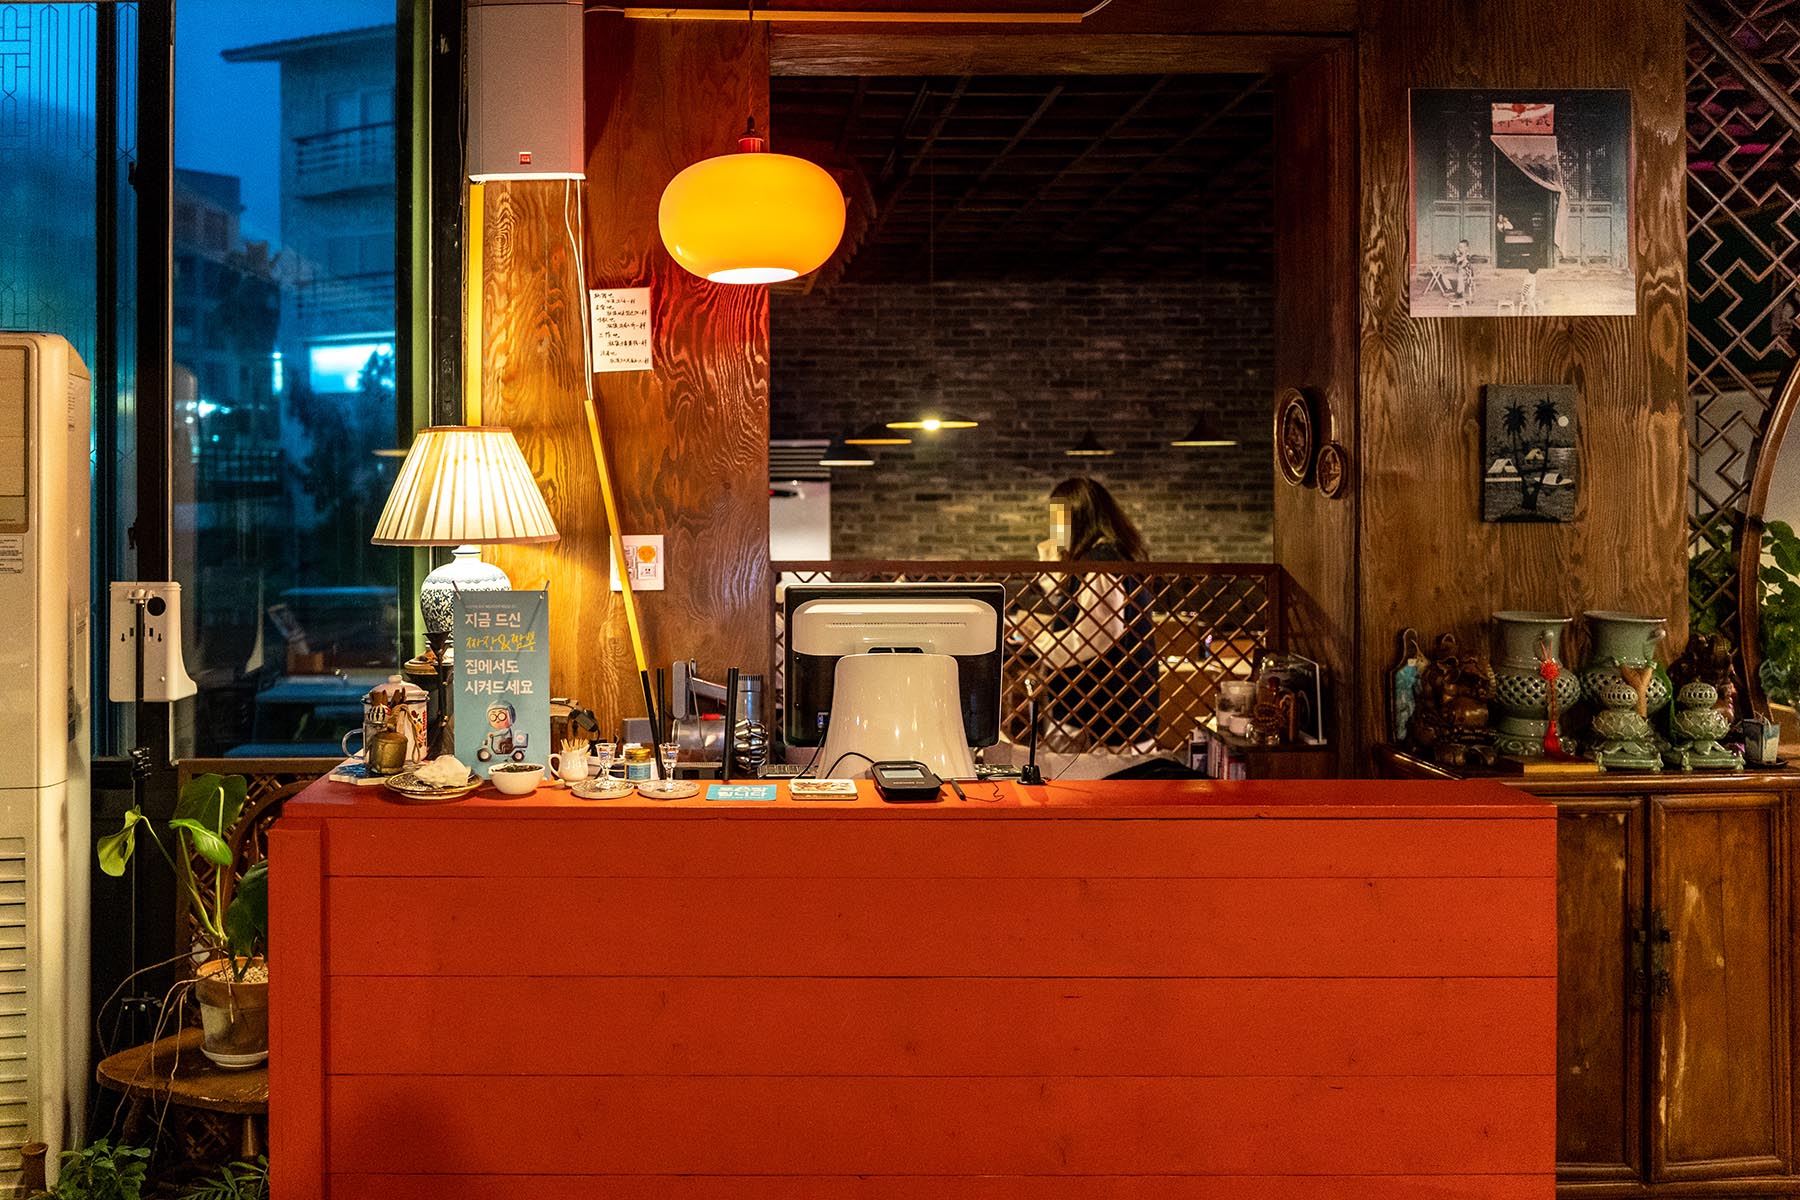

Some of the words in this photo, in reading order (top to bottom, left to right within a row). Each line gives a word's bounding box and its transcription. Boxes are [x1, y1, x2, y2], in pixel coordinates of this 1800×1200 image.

[465, 612, 491, 628] 지금
[495, 612, 521, 628] 드신
[465, 659, 519, 675] 집에서도
[465, 680, 534, 695] 시켜드세요
